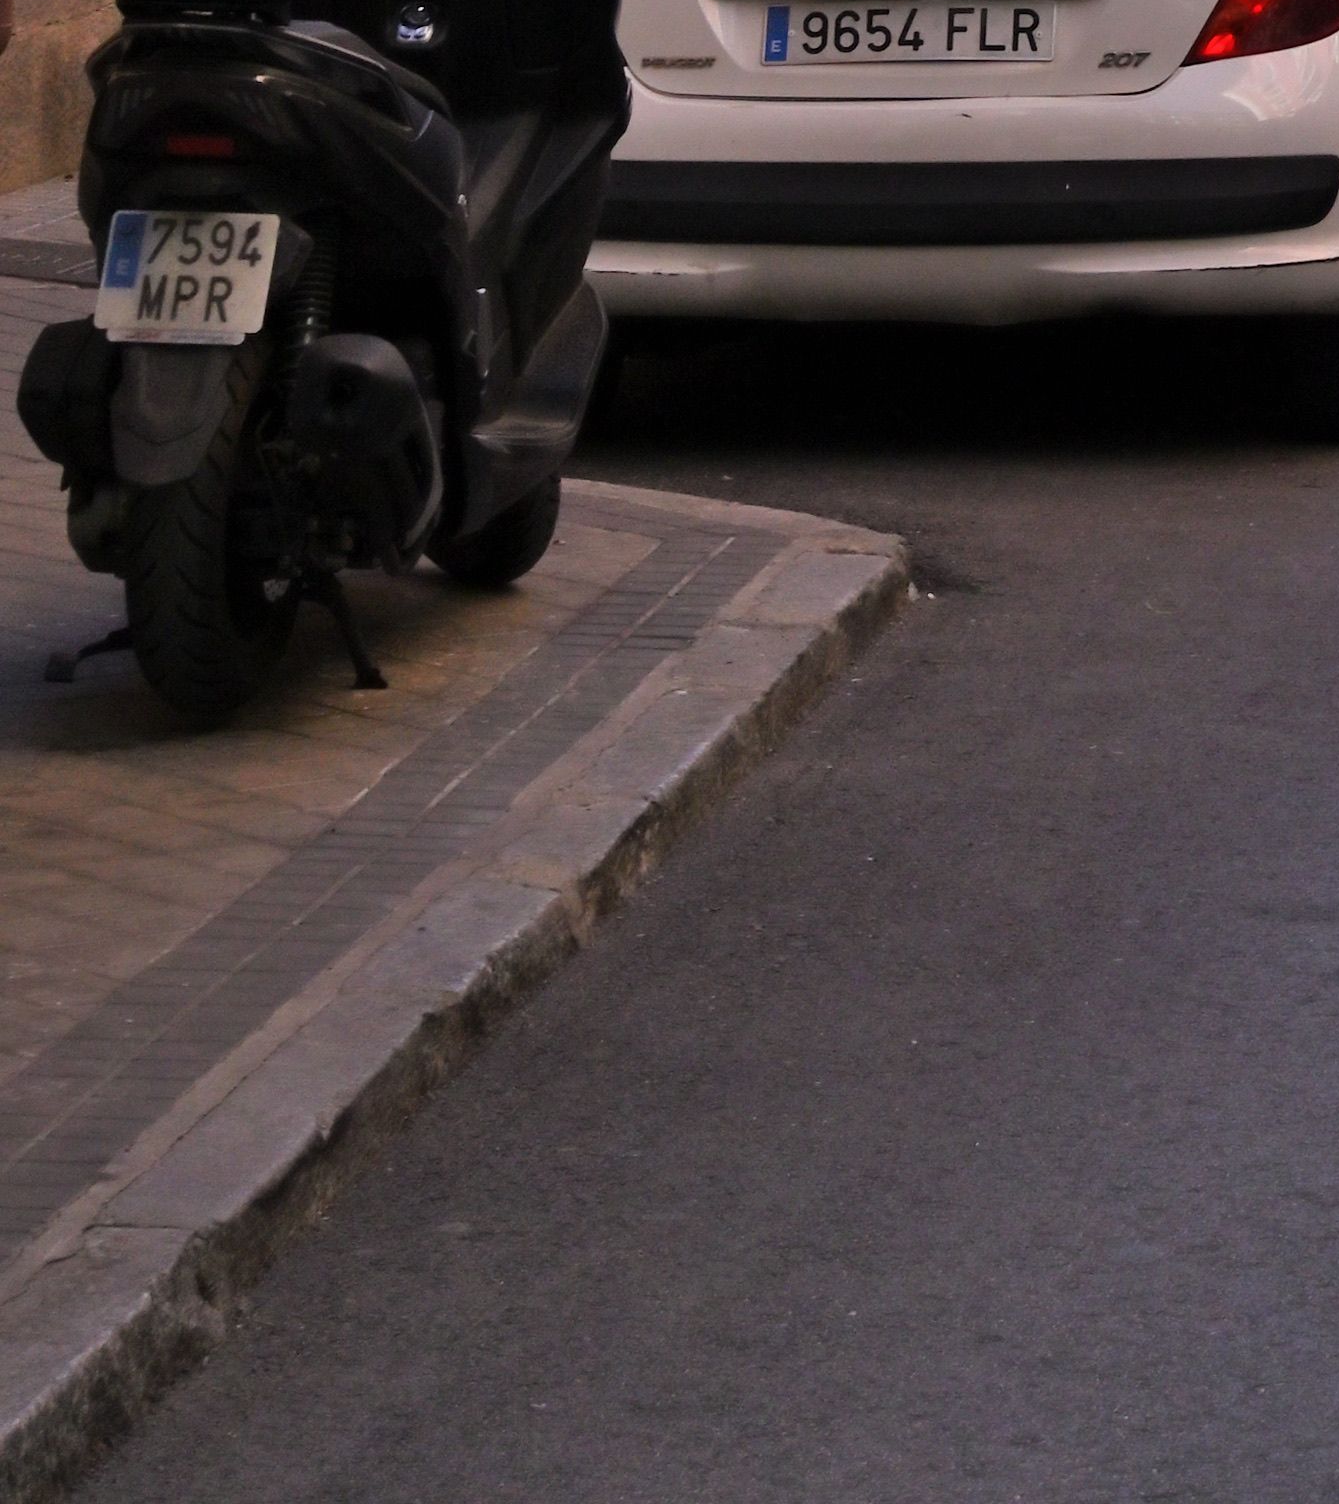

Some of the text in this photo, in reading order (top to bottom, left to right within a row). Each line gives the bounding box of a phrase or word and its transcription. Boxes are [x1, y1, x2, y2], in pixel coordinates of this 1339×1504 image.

[802, 7, 924, 55] 9654
[946, 7, 1041, 52] FLR
[1097, 50, 1152, 69] 207
[148, 218, 262, 267] 7594
[137, 274, 233, 323] MPR
